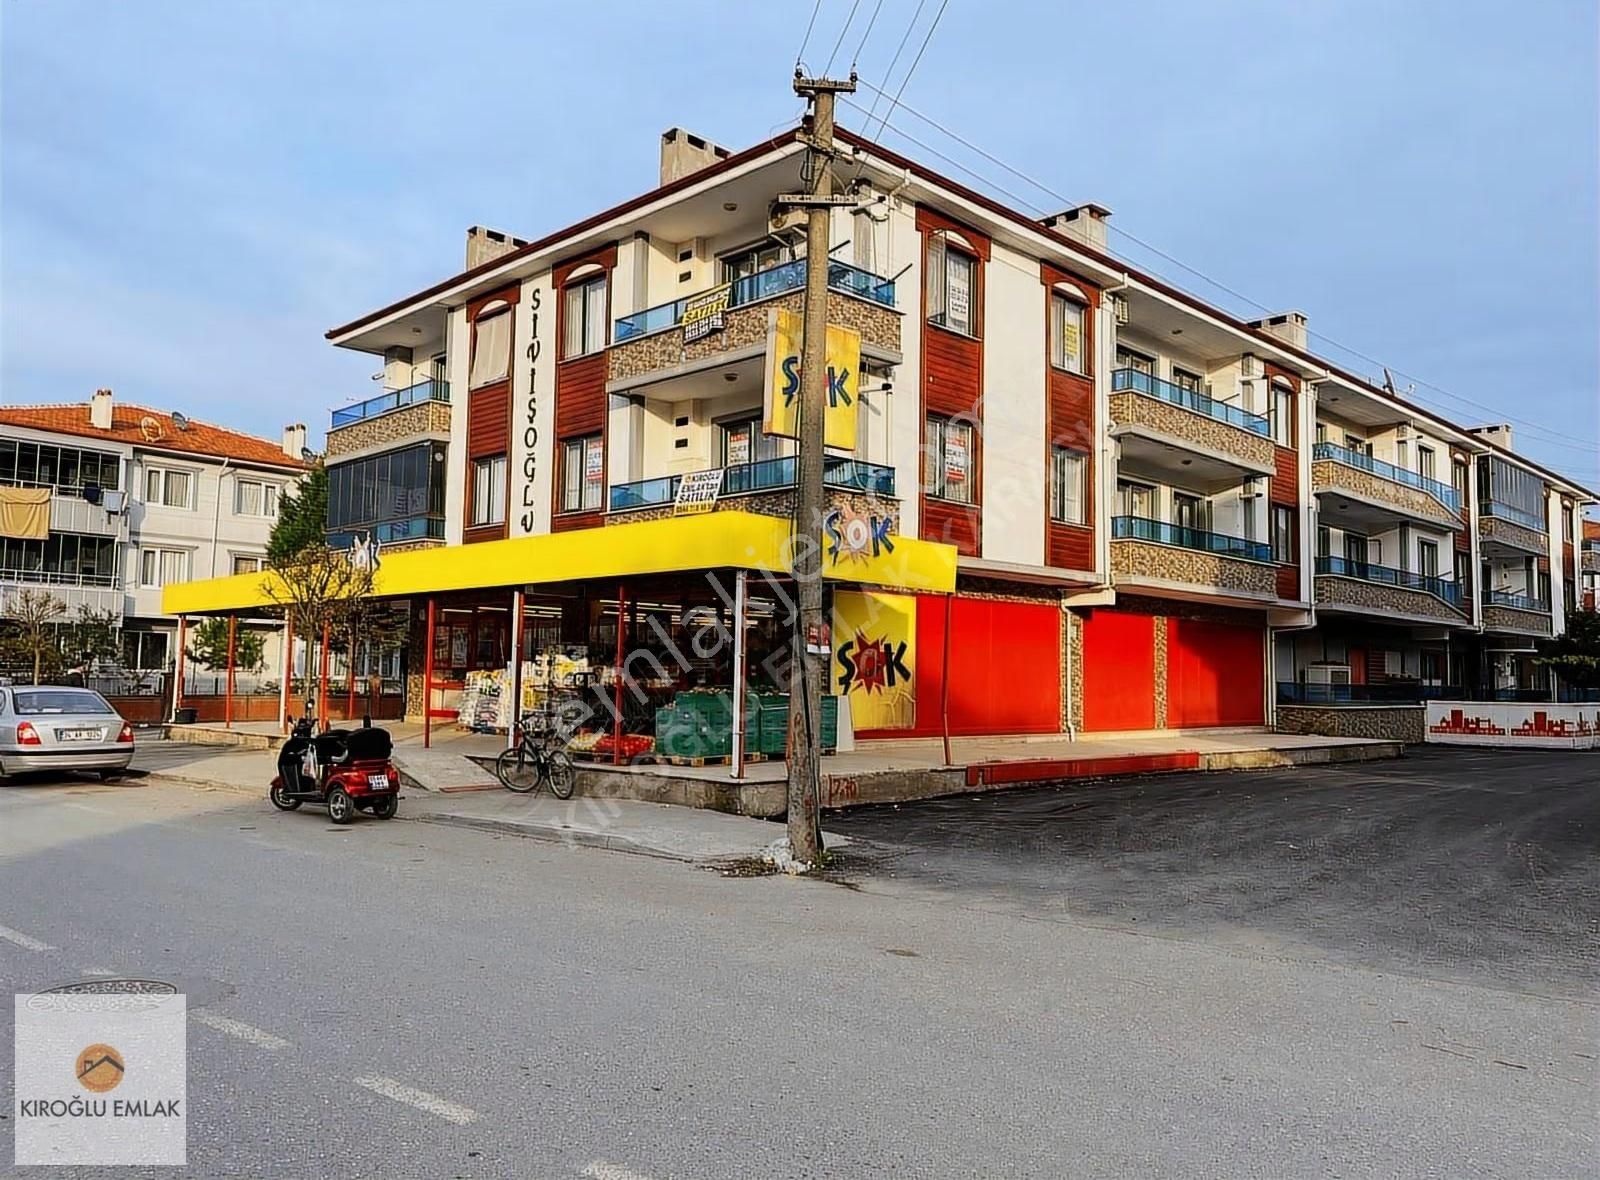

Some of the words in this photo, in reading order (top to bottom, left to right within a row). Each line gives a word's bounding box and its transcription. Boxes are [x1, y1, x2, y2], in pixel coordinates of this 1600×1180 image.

[782, 356, 852, 408] ŞK
[823, 511, 896, 567] ŞOK
[837, 641, 911, 695] ŞOK
